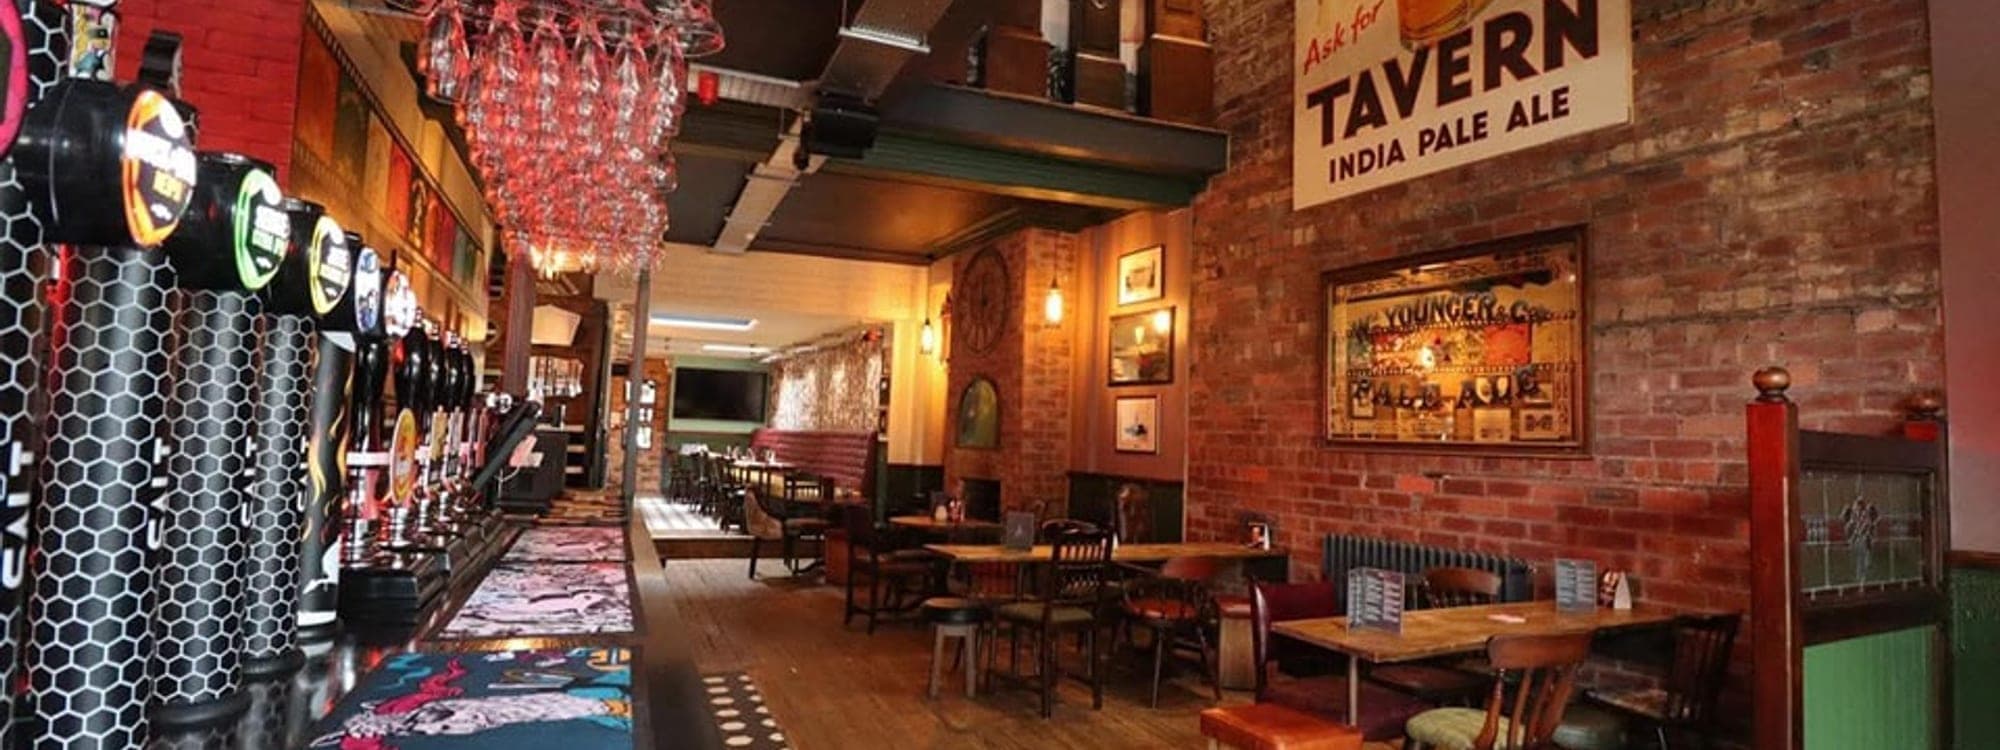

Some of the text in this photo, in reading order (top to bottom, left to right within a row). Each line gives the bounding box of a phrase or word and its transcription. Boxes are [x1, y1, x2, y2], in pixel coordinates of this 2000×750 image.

[1303, 0, 1384, 76] Ask for
[1306, 0, 1599, 147] TAVERN
[1329, 86, 1570, 183] INDIA PALE ALE
[1384, 292, 1498, 329] YOUNGER
